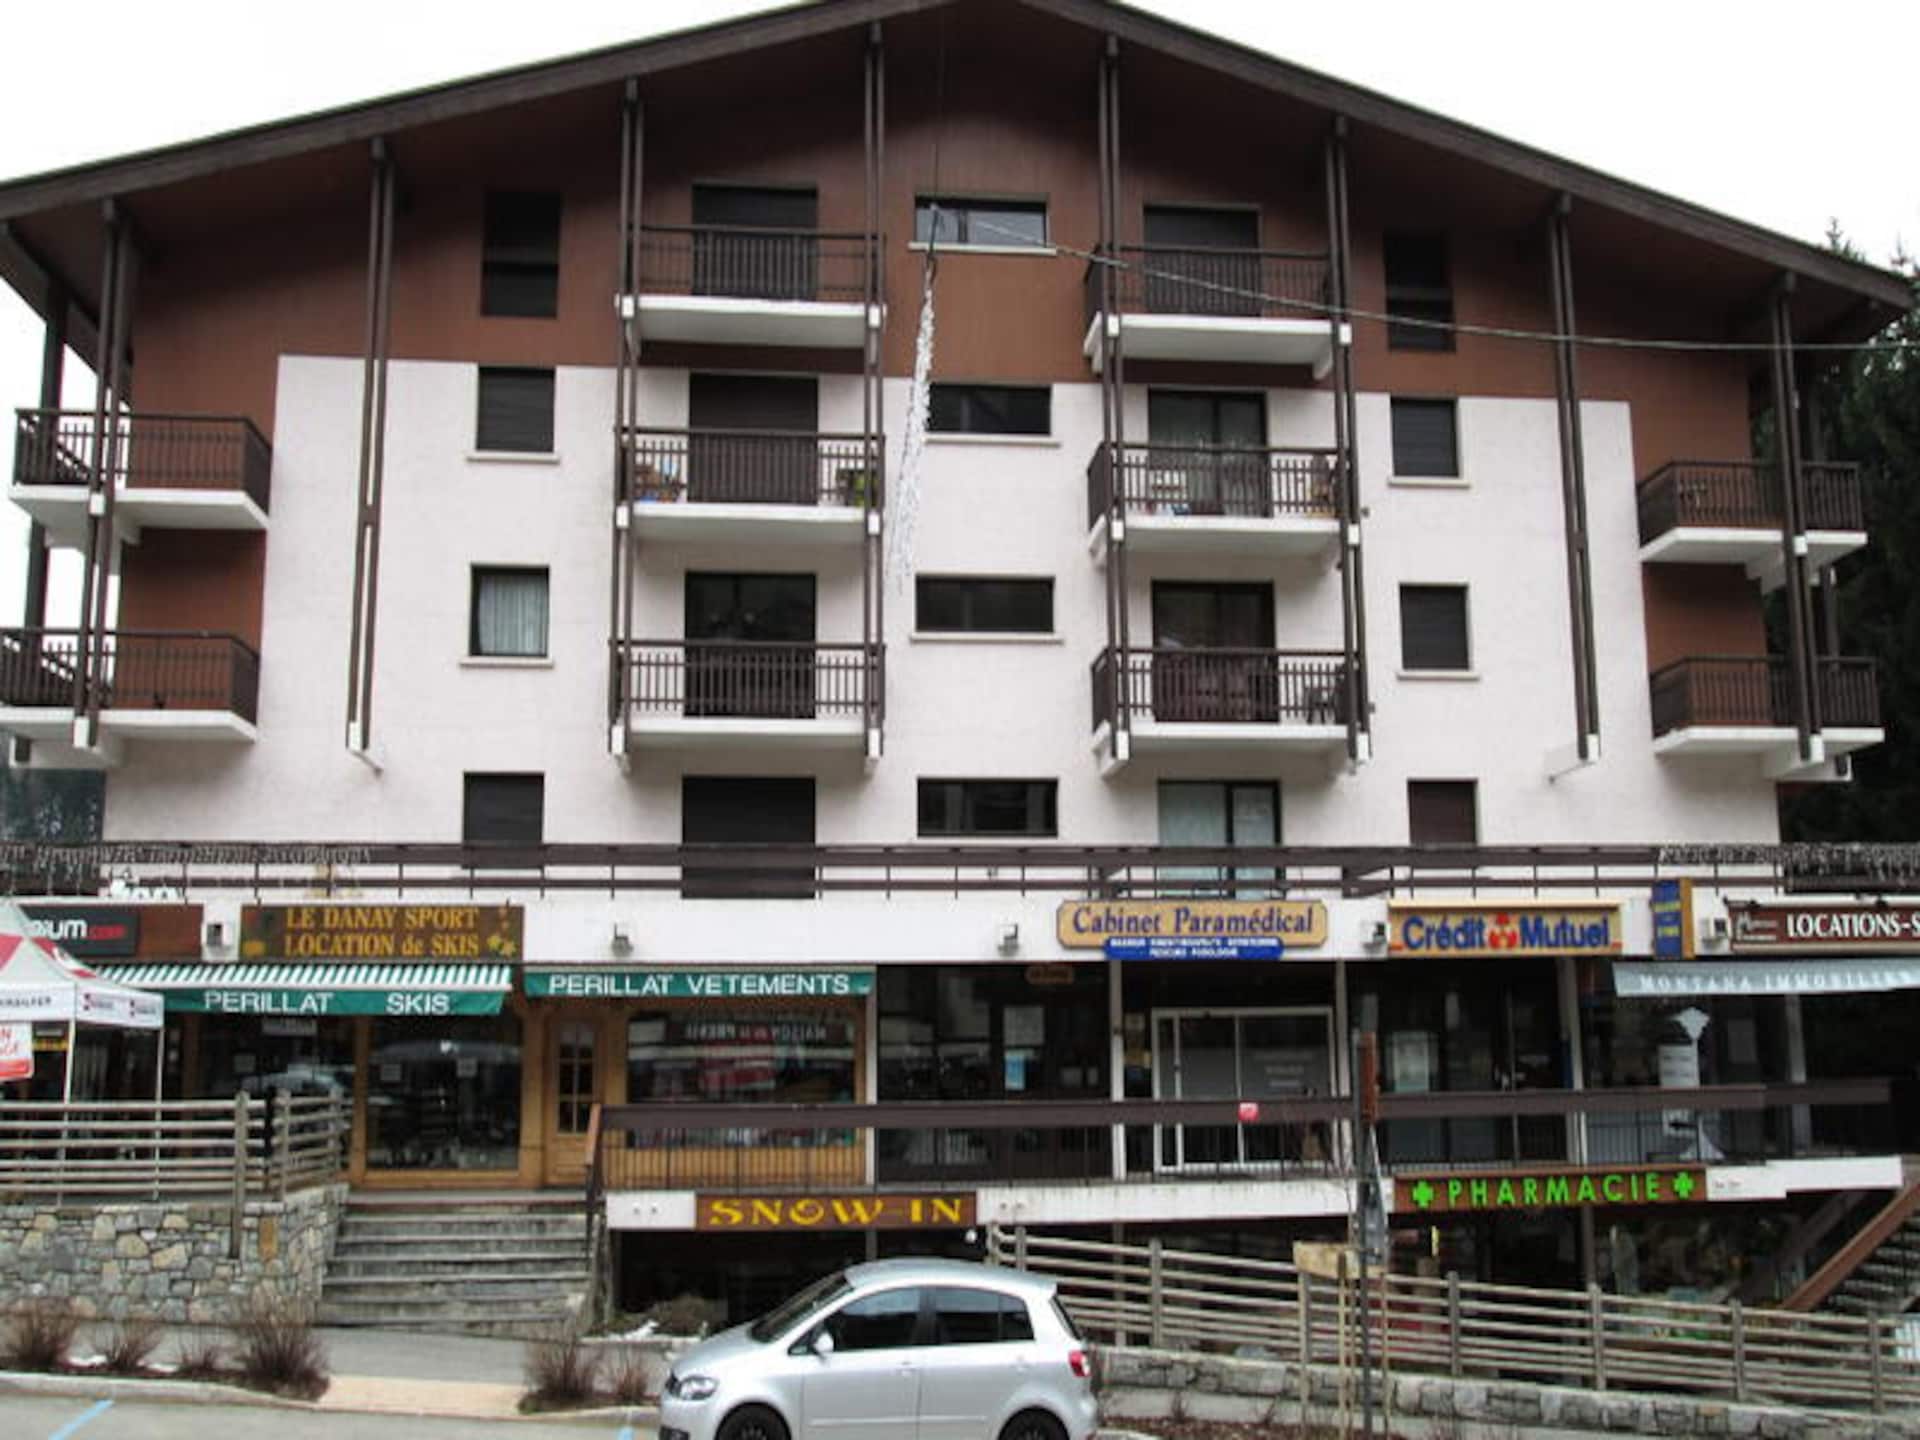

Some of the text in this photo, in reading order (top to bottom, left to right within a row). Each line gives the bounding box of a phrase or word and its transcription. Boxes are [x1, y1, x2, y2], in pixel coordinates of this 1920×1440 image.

[286, 907, 479, 928] LE DANAY SPORT
[1073, 906, 1313, 934] Cabinet Paramédical
[1403, 914, 1609, 949] Crédit Mutuel
[285, 935, 396, 957] LOCATION
[431, 935, 479, 957] SKIS
[549, 973, 849, 995] PERILLAT VETEMENTS
[203, 991, 450, 1015] PERILLAT SKIS
[1449, 1171, 1661, 1208] PHARMACIE
